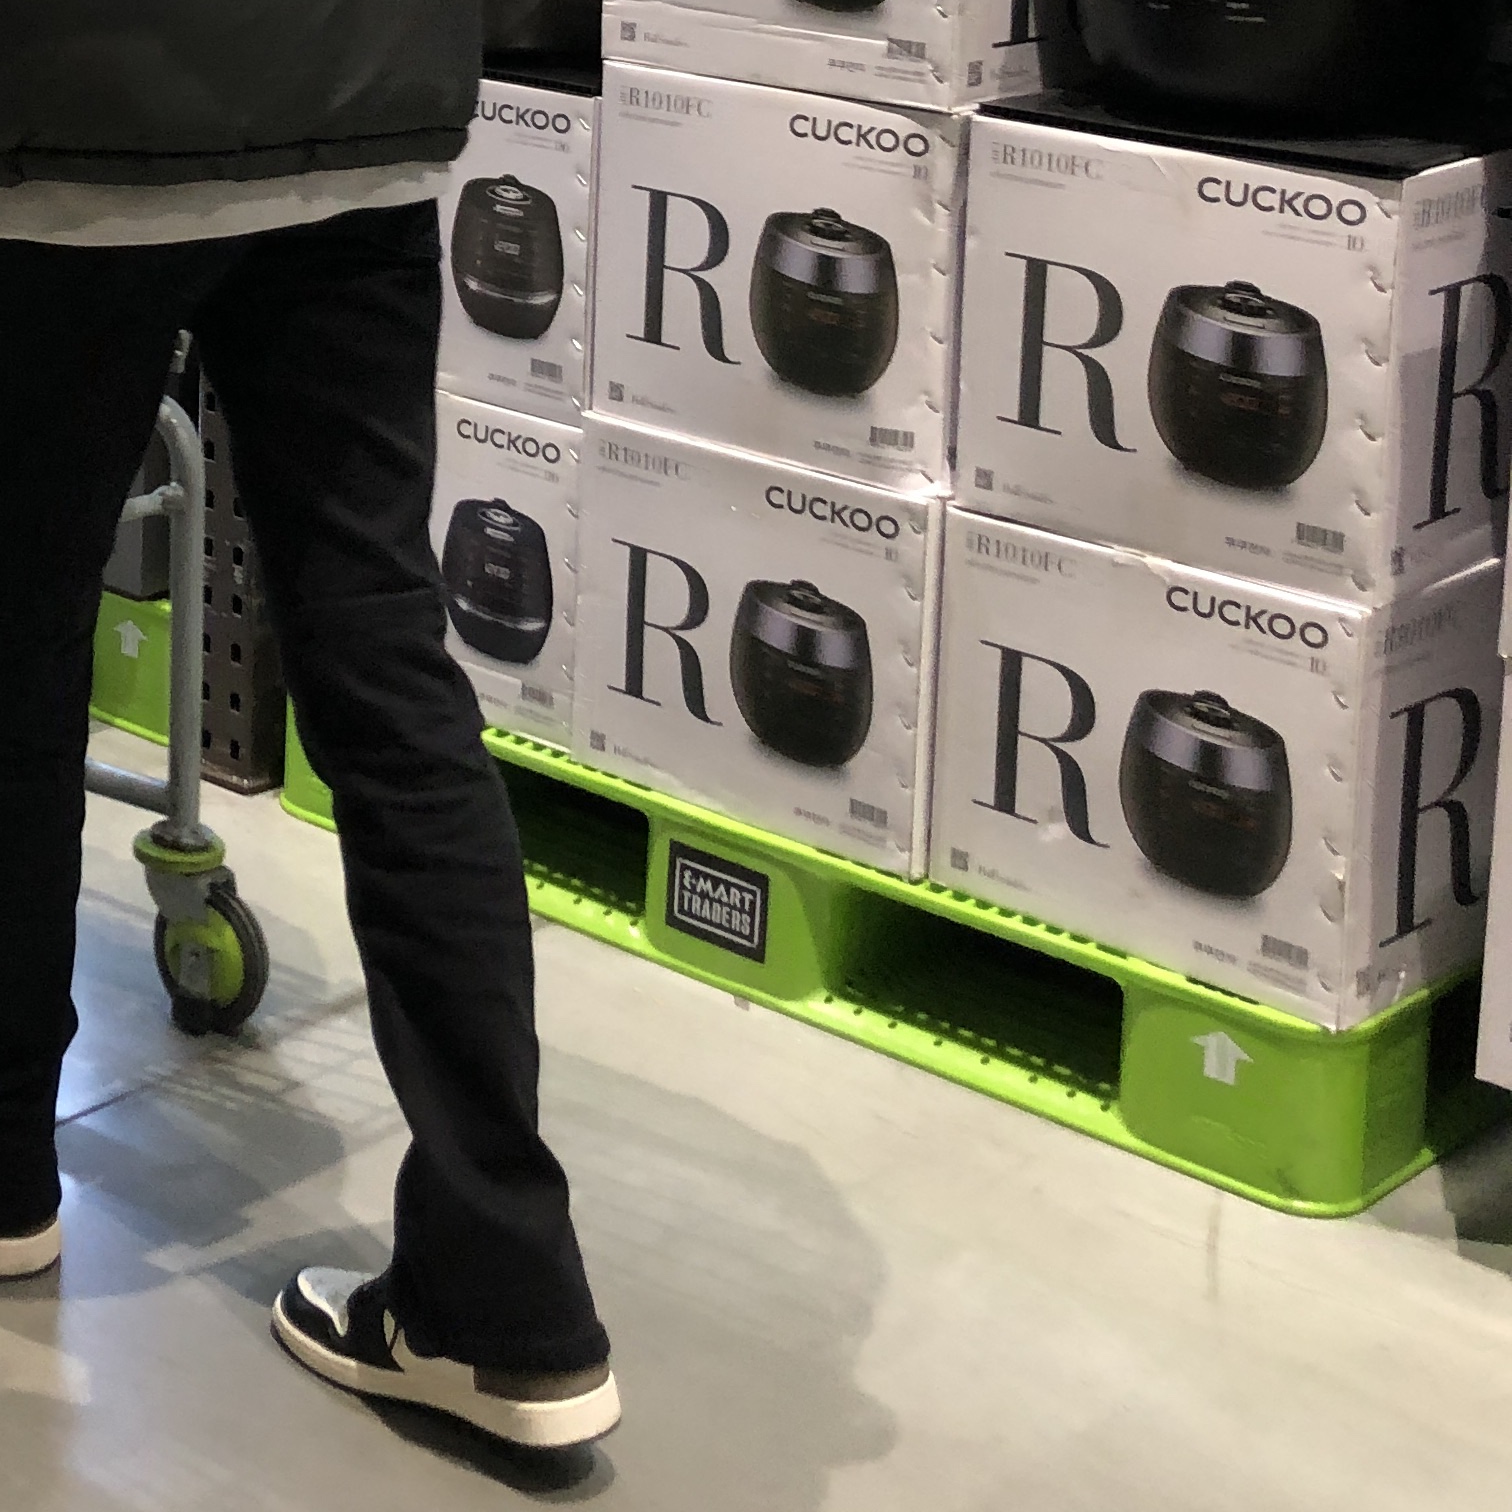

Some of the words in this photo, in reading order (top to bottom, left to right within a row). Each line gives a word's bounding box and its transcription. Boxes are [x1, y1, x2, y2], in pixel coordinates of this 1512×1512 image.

[628, 85, 714, 117] R1010FC
[788, 112, 930, 158] CUCKOO
[1000, 143, 1104, 182] R1010FC
[1196, 175, 1367, 227] CUCKOO
[625, 183, 742, 366] R
[995, 250, 1138, 454] R
[1412, 272, 1512, 532] R
[455, 416, 561, 466] CUCKOO
[764, 484, 900, 540] CUCKOO
[975, 532, 1076, 577] R1010FC
[607, 537, 724, 728] R
[1166, 583, 1330, 650] CUCKOO
[971, 638, 1112, 850] R
[1379, 686, 1484, 950] R
[681, 889, 752, 937] TRADERS
